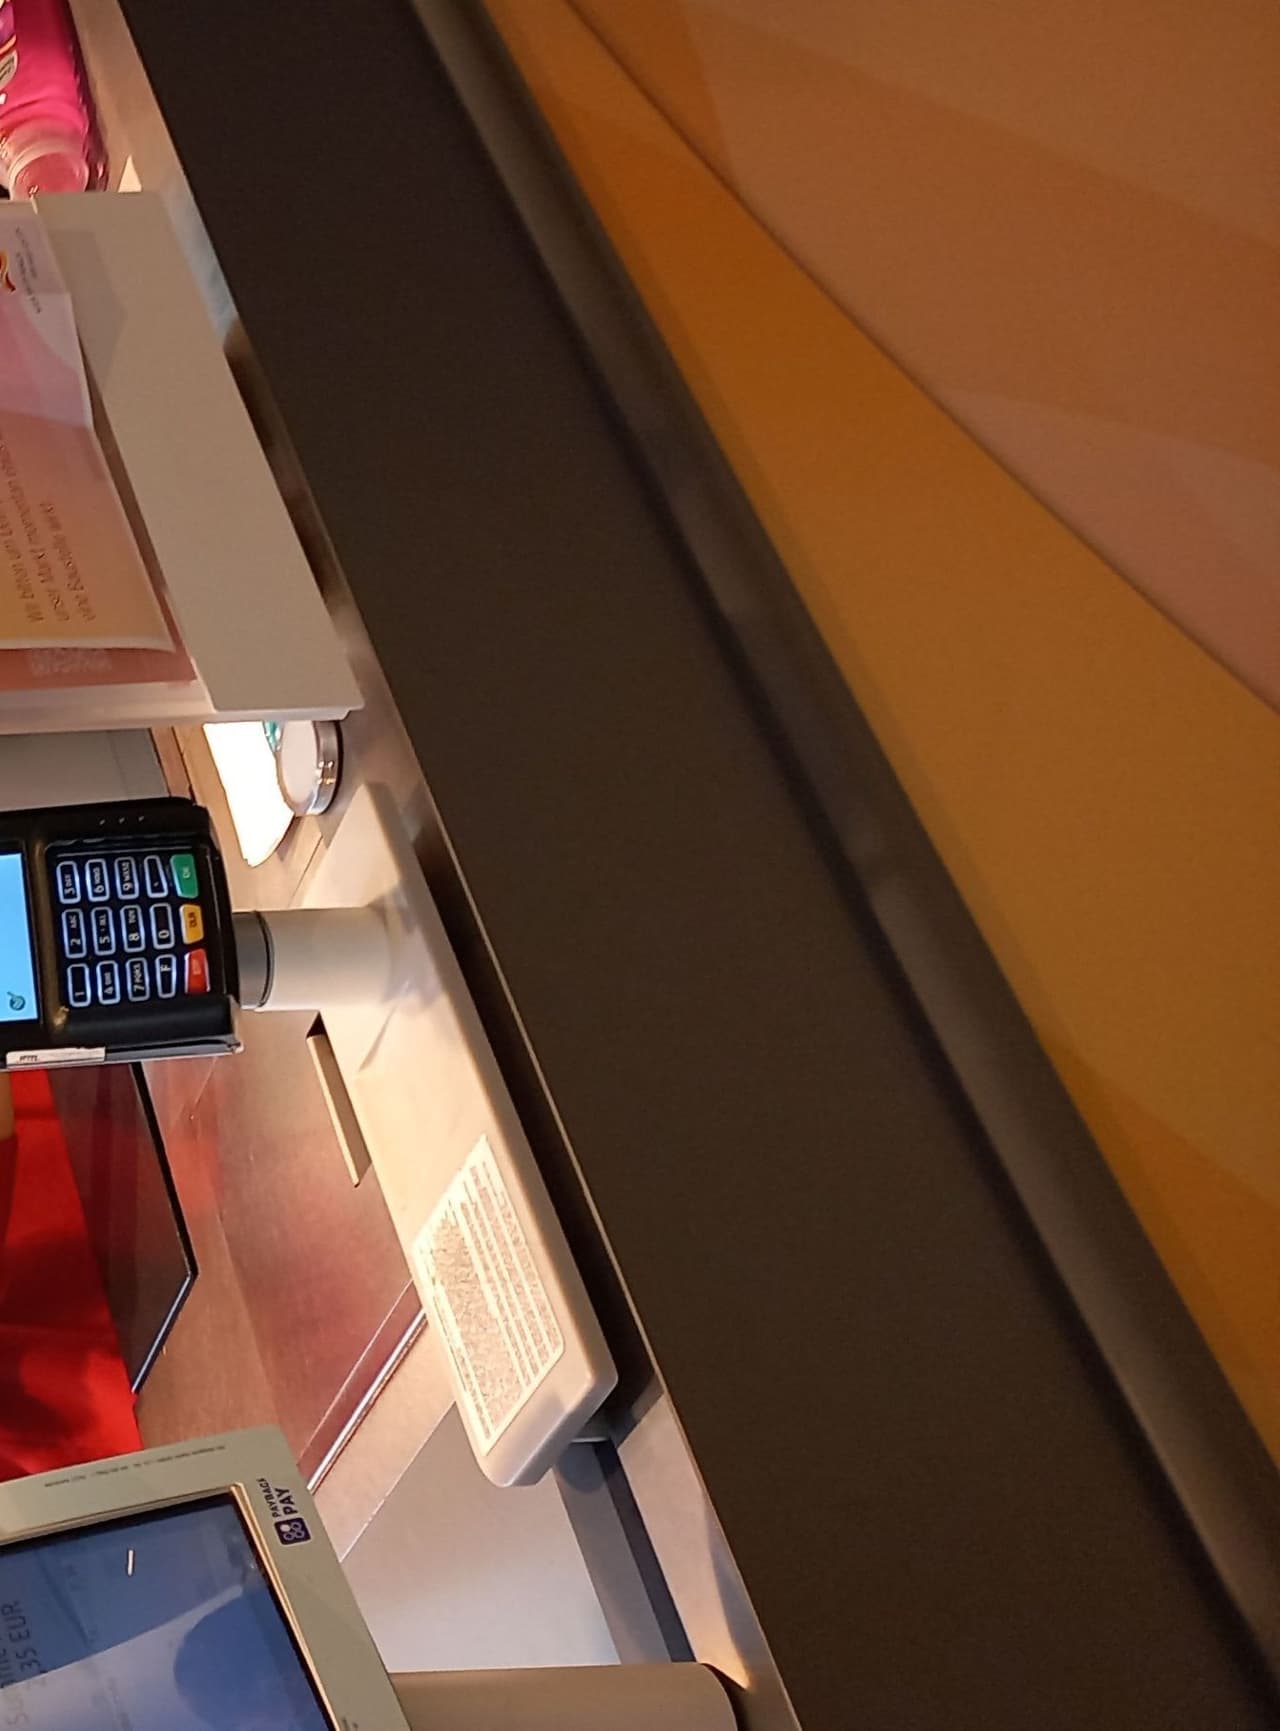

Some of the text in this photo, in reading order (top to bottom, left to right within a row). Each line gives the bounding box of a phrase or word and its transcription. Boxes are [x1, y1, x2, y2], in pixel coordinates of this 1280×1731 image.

[64, 887, 75, 895] 3
[94, 885, 105, 893] 6
[122, 882, 133, 891] 9
[128, 932, 139, 942] 8
[70, 938, 81, 946] 2
[275, 1488, 298, 1515] PAY
[0, 1600, 30, 1643] EUR
